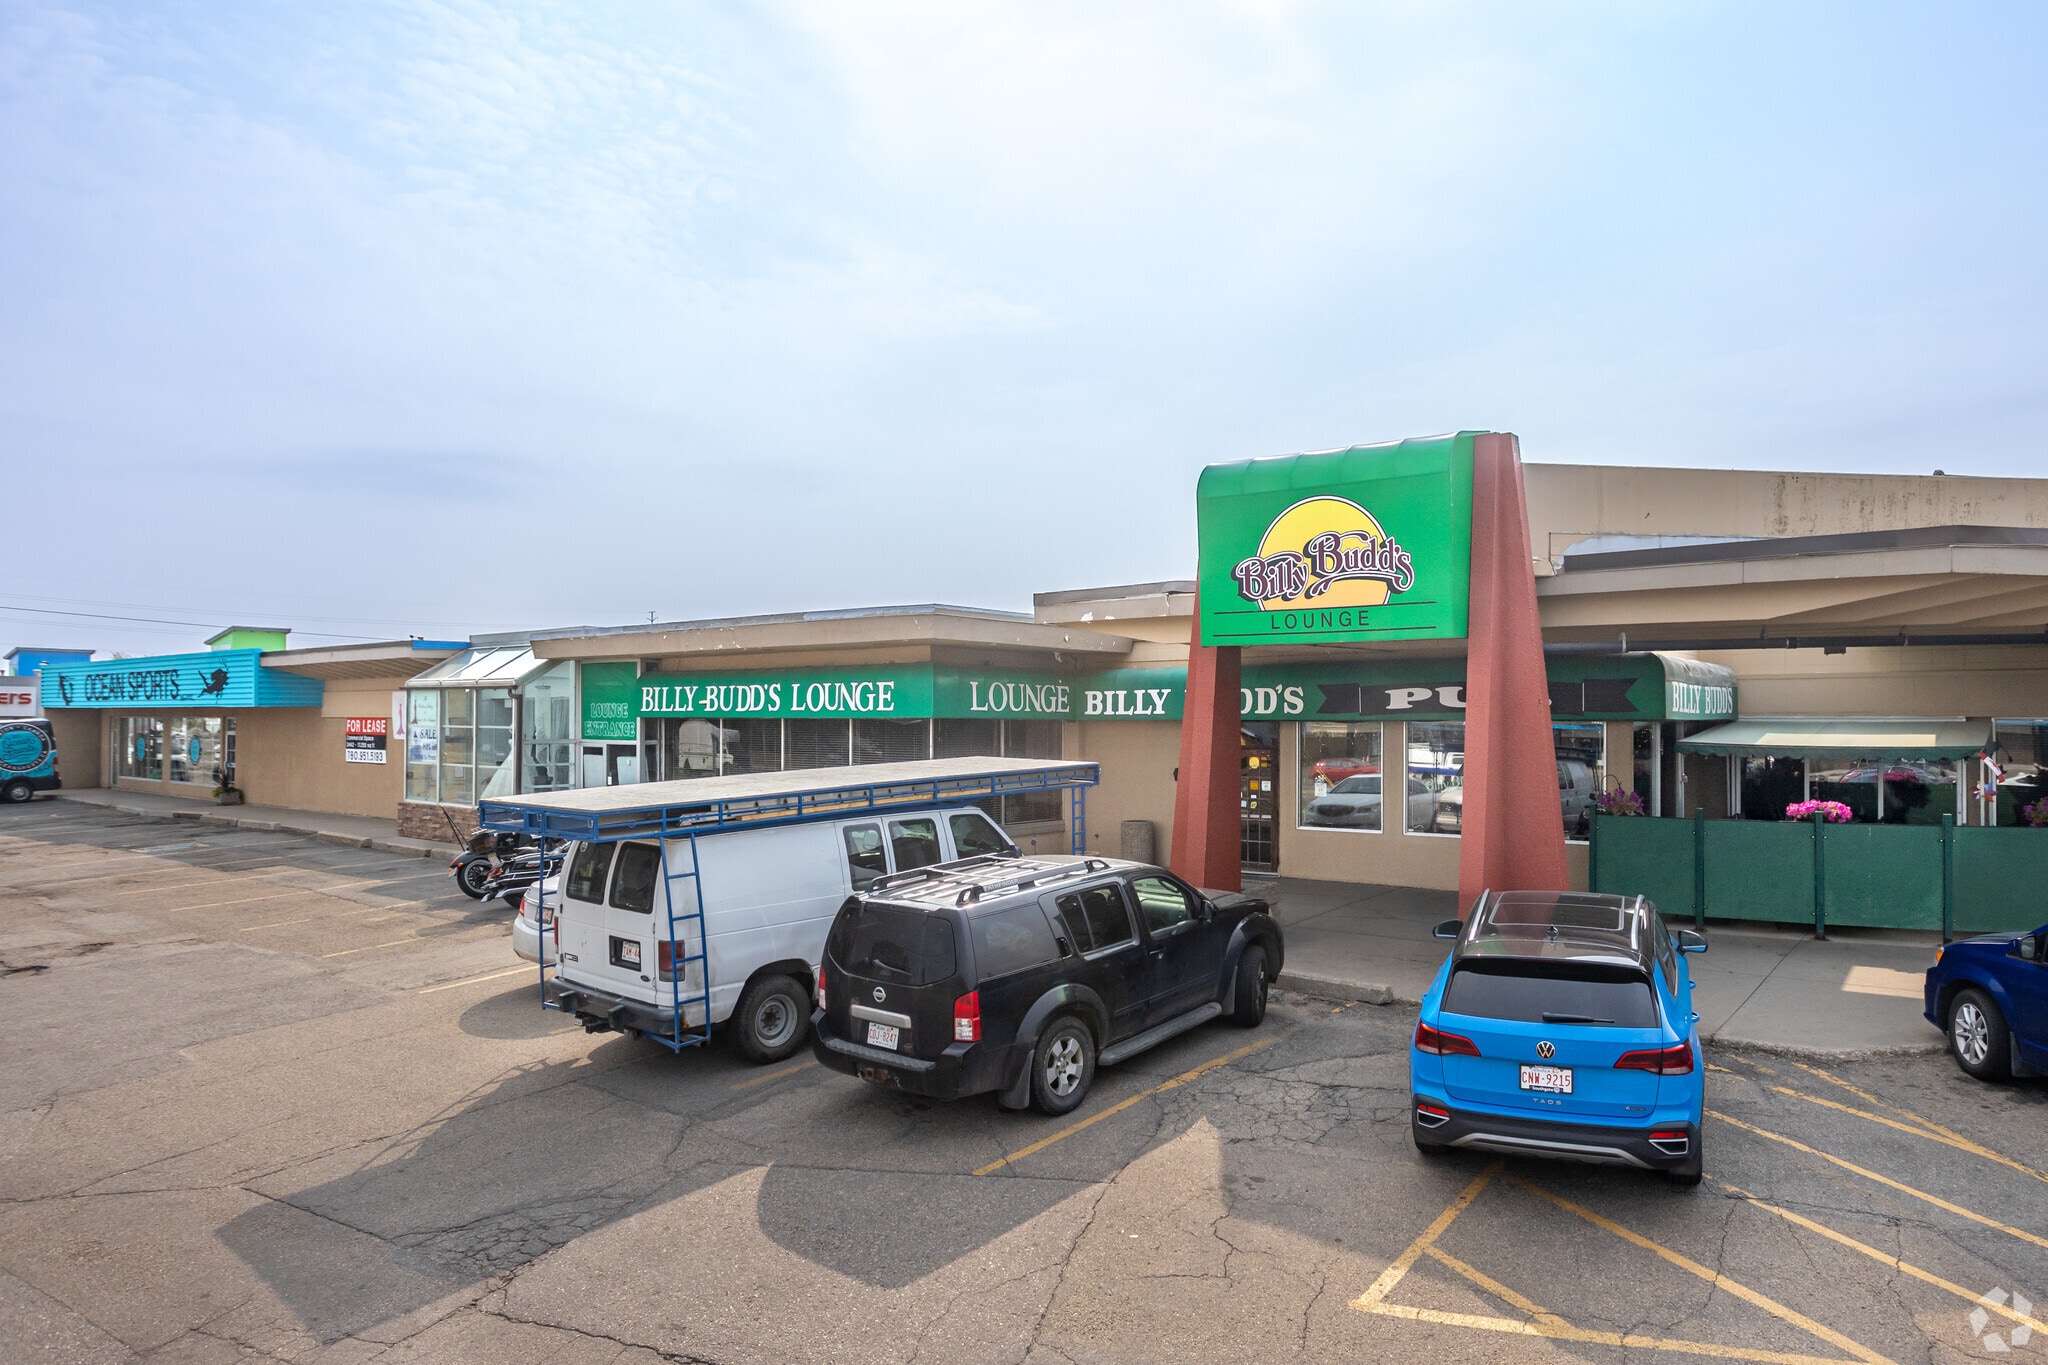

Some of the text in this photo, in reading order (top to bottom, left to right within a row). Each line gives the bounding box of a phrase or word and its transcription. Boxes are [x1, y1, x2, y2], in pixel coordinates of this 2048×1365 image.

[1232, 530, 1415, 601] Billy Budd's
[1271, 610, 1370, 630] LOUNGE
[85, 669, 180, 701] OCEAN SPORTS
[790, 680, 895, 711] LOUNGE
[970, 681, 1070, 713] LOUNGE
[1084, 688, 1171, 716] BILLY
[1384, 686, 1466, 710] PU
[1671, 681, 1701, 714] BILLY
[590, 703, 629, 718] LOUNGE
[346, 719, 386, 733] FOR LEASE
[420, 728, 437, 739] SALE
[584, 721, 636, 737] ENTRANCE
[983, 878, 1020, 893] PATHFINDER
[1521, 1071, 1571, 1087] CNW-9215
